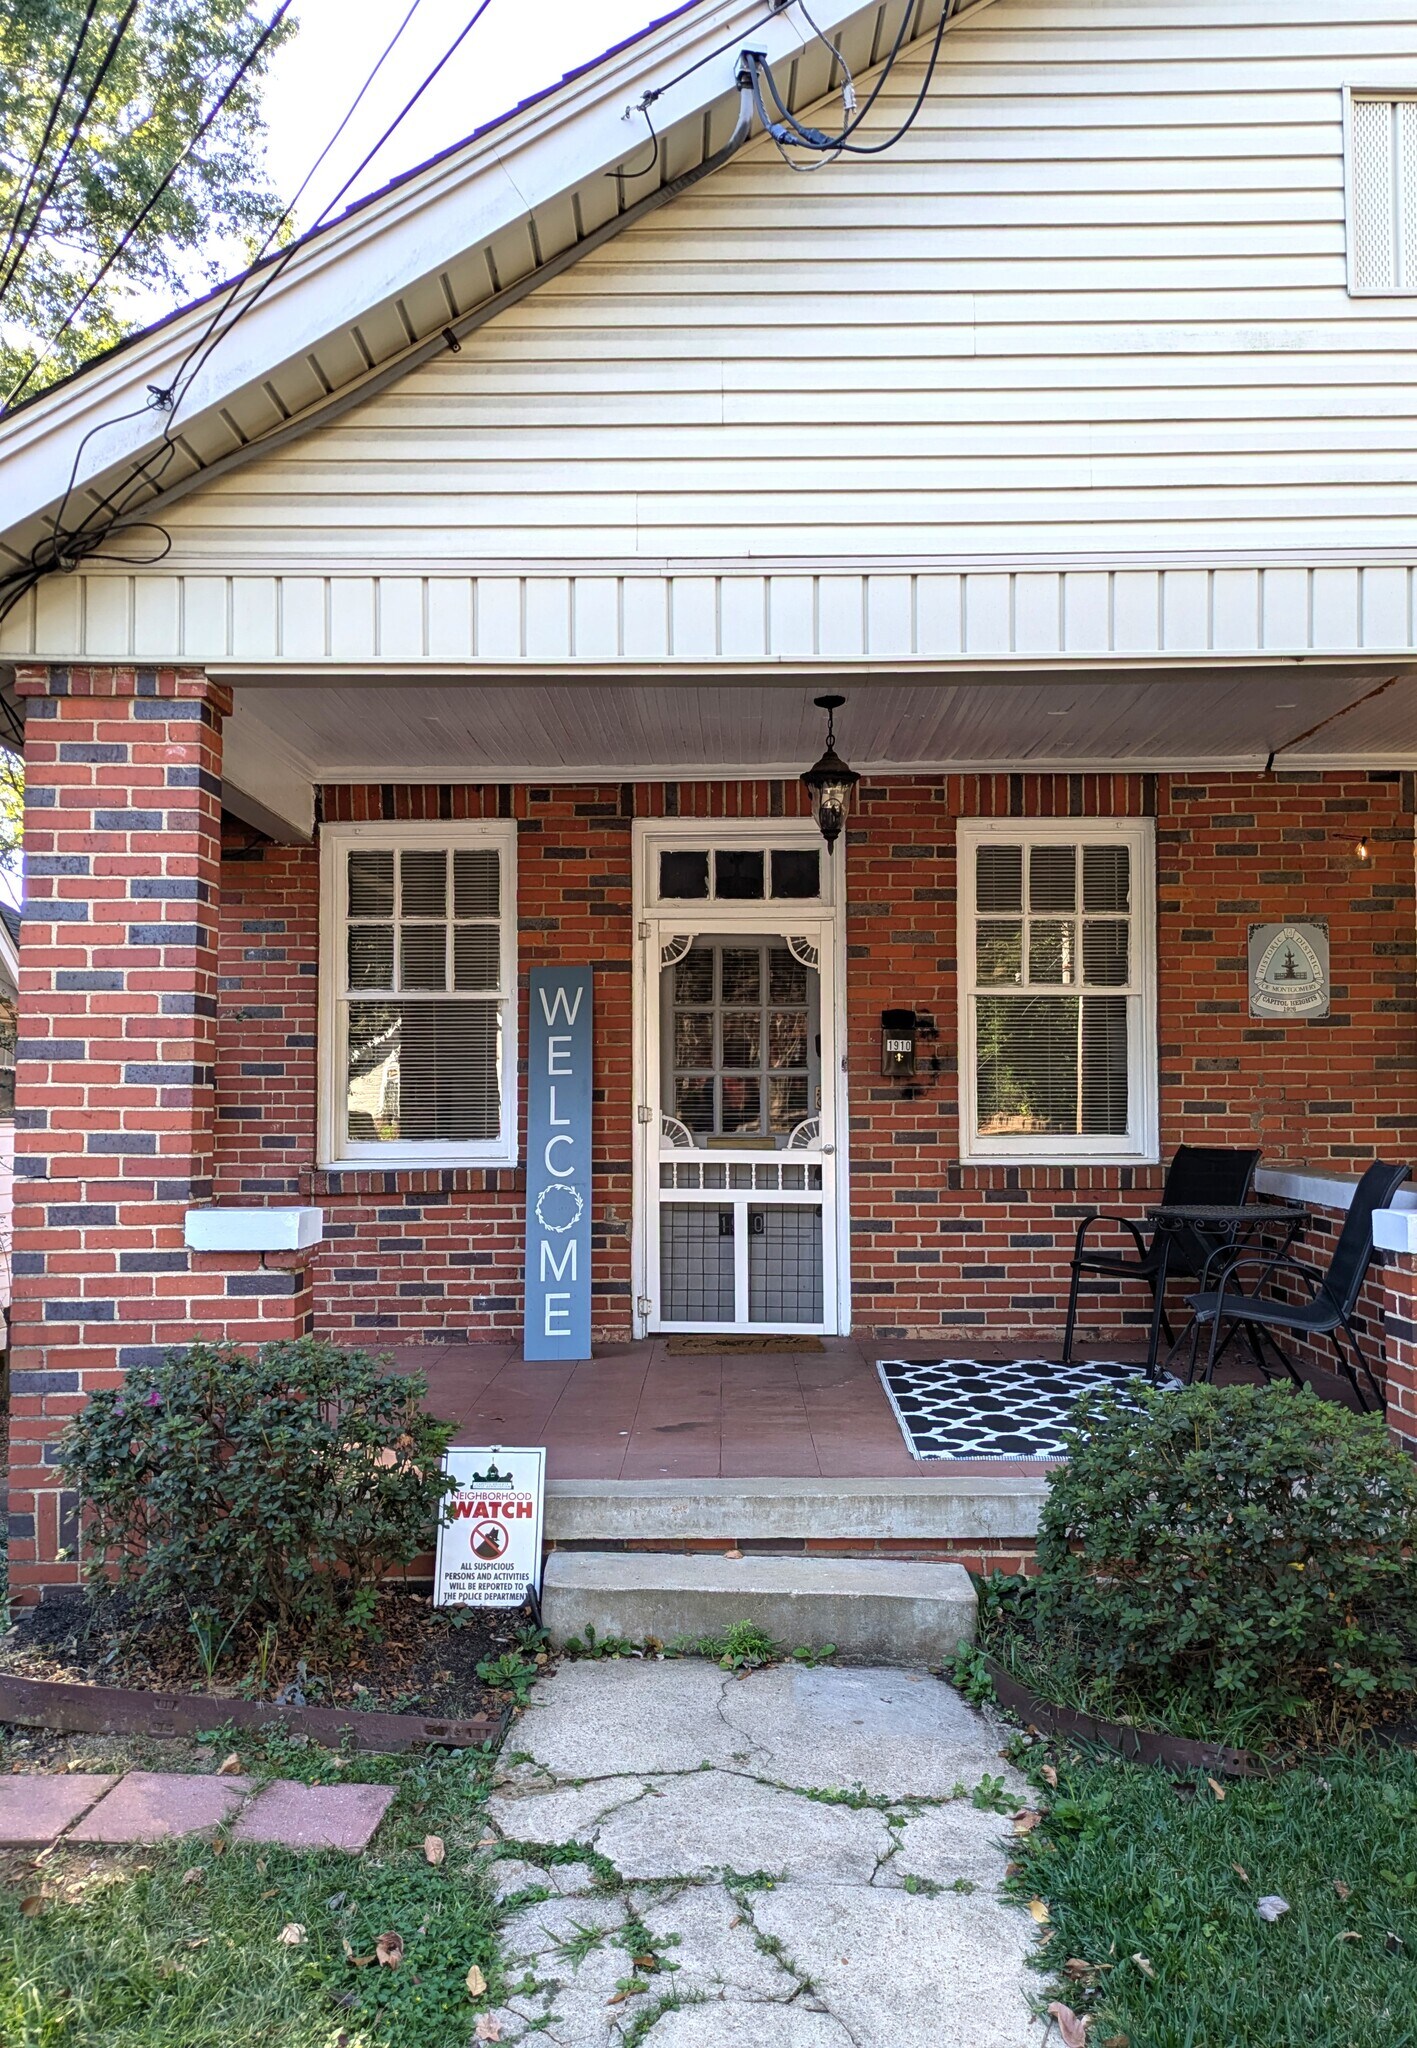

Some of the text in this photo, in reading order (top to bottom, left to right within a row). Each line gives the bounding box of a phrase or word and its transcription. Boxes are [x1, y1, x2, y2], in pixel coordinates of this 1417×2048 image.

[1258, 936, 1321, 976] HISTORIC DISTRICT
[1272, 984, 1316, 993] MONTGOMERY
[1262, 994, 1318, 1007] CAPITOL HEIGHTS
[888, 1041, 911, 1051] 1910
[535, 987, 584, 1336] WELCOME
[451, 1491, 532, 1501] NEIGHBORHOOD
[450, 1501, 533, 1519] WATCH
[460, 1562, 515, 1571] ALL SUSPICIOUS
[444, 1572, 530, 1581] PERSONS AND ACTIVITIES
[449, 1582, 524, 1590] WILL BE REPORTED TO
[443, 1592, 457, 1600] THE
[458, 1592, 482, 1600] POLICE
